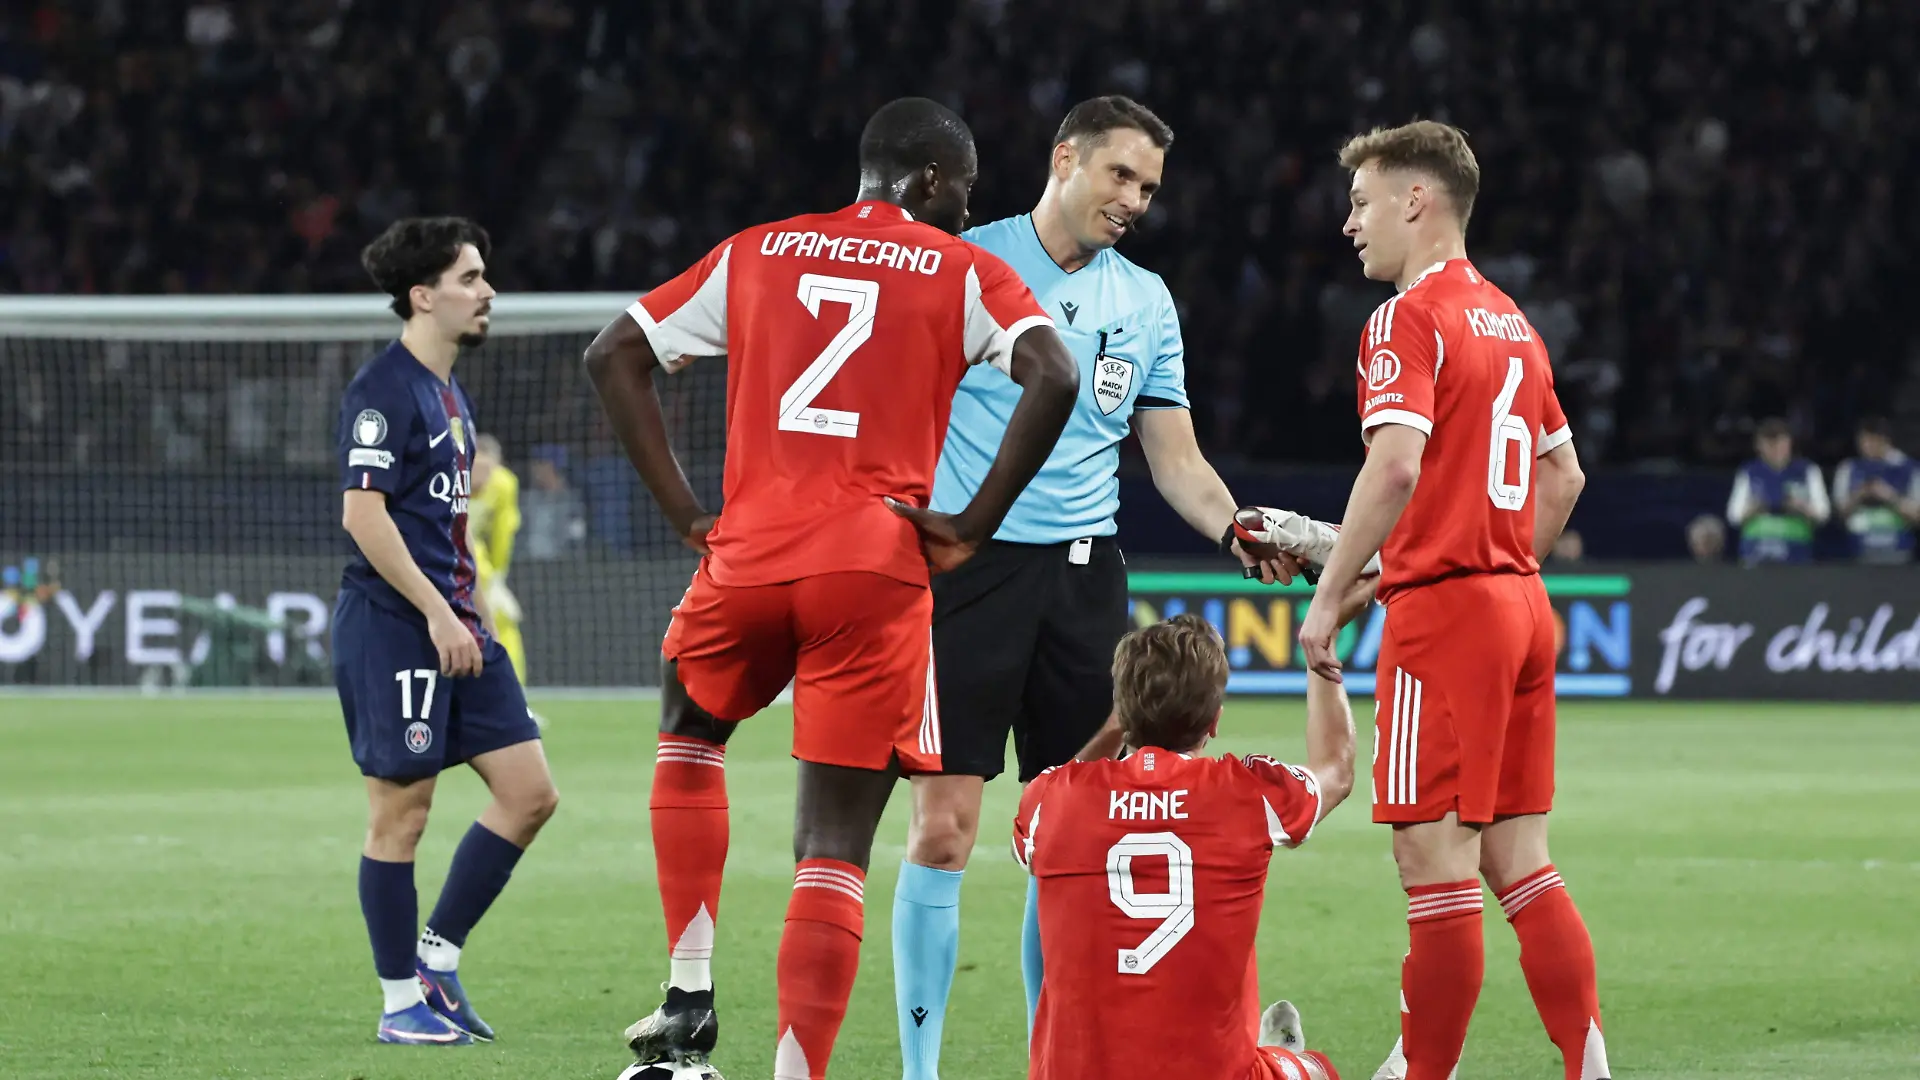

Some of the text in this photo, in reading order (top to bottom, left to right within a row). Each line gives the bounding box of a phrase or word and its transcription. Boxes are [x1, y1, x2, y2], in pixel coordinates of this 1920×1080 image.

[760, 231, 943, 276] UPAMECANO
[1464, 307, 1533, 343] KIMMIC
[777, 272, 880, 439] 2
[1103, 364, 1125, 376] UEFA
[1097, 387, 1122, 400] OFFICIAL
[1101, 380, 1122, 390] MATCH
[1364, 392, 1404, 413] Allianz
[1487, 356, 1533, 512] 6
[1655, 597, 1754, 694] for
[395, 668, 438, 720] 17
[1108, 789, 1189, 820] KANE
[1106, 831, 1195, 975] 9
